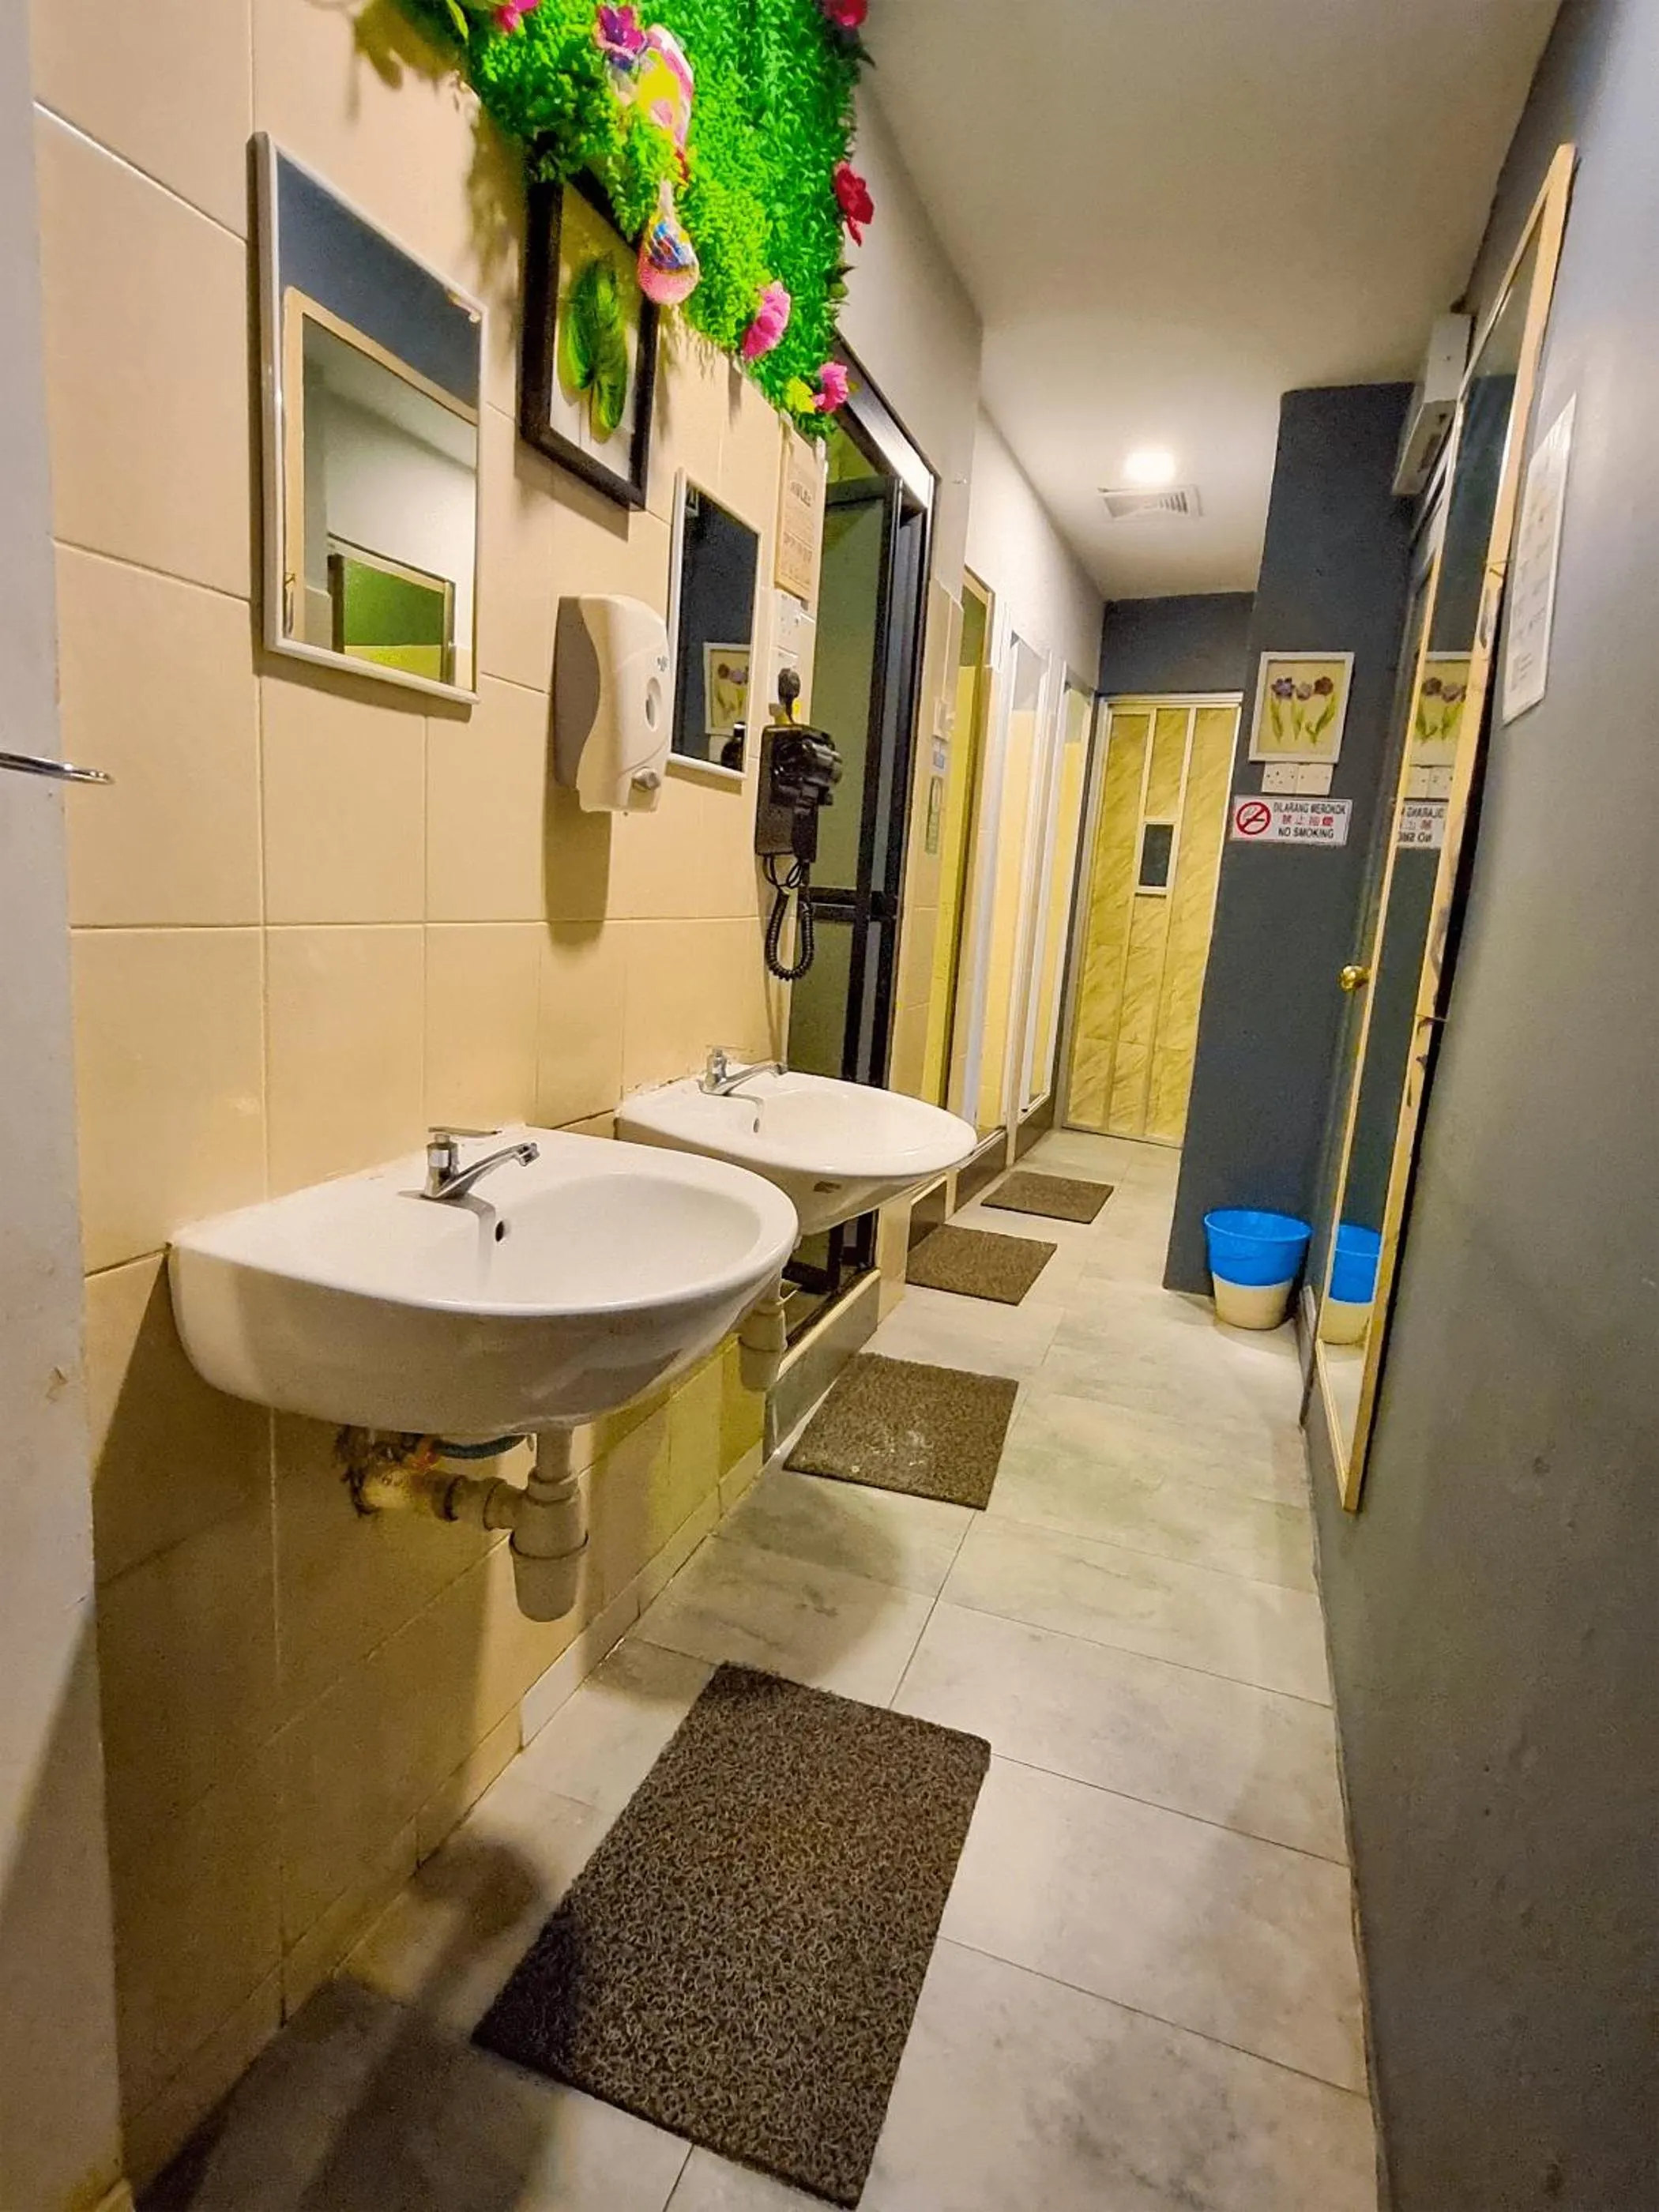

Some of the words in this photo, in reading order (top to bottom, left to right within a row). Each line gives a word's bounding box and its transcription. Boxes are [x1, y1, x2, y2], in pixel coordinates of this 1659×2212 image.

[1273, 802, 1309, 813] DILARANG
[1311, 803, 1346, 814] MEROKOK
[1277, 826, 1291, 837] NO
[1292, 827, 1334, 839] SMOKING
